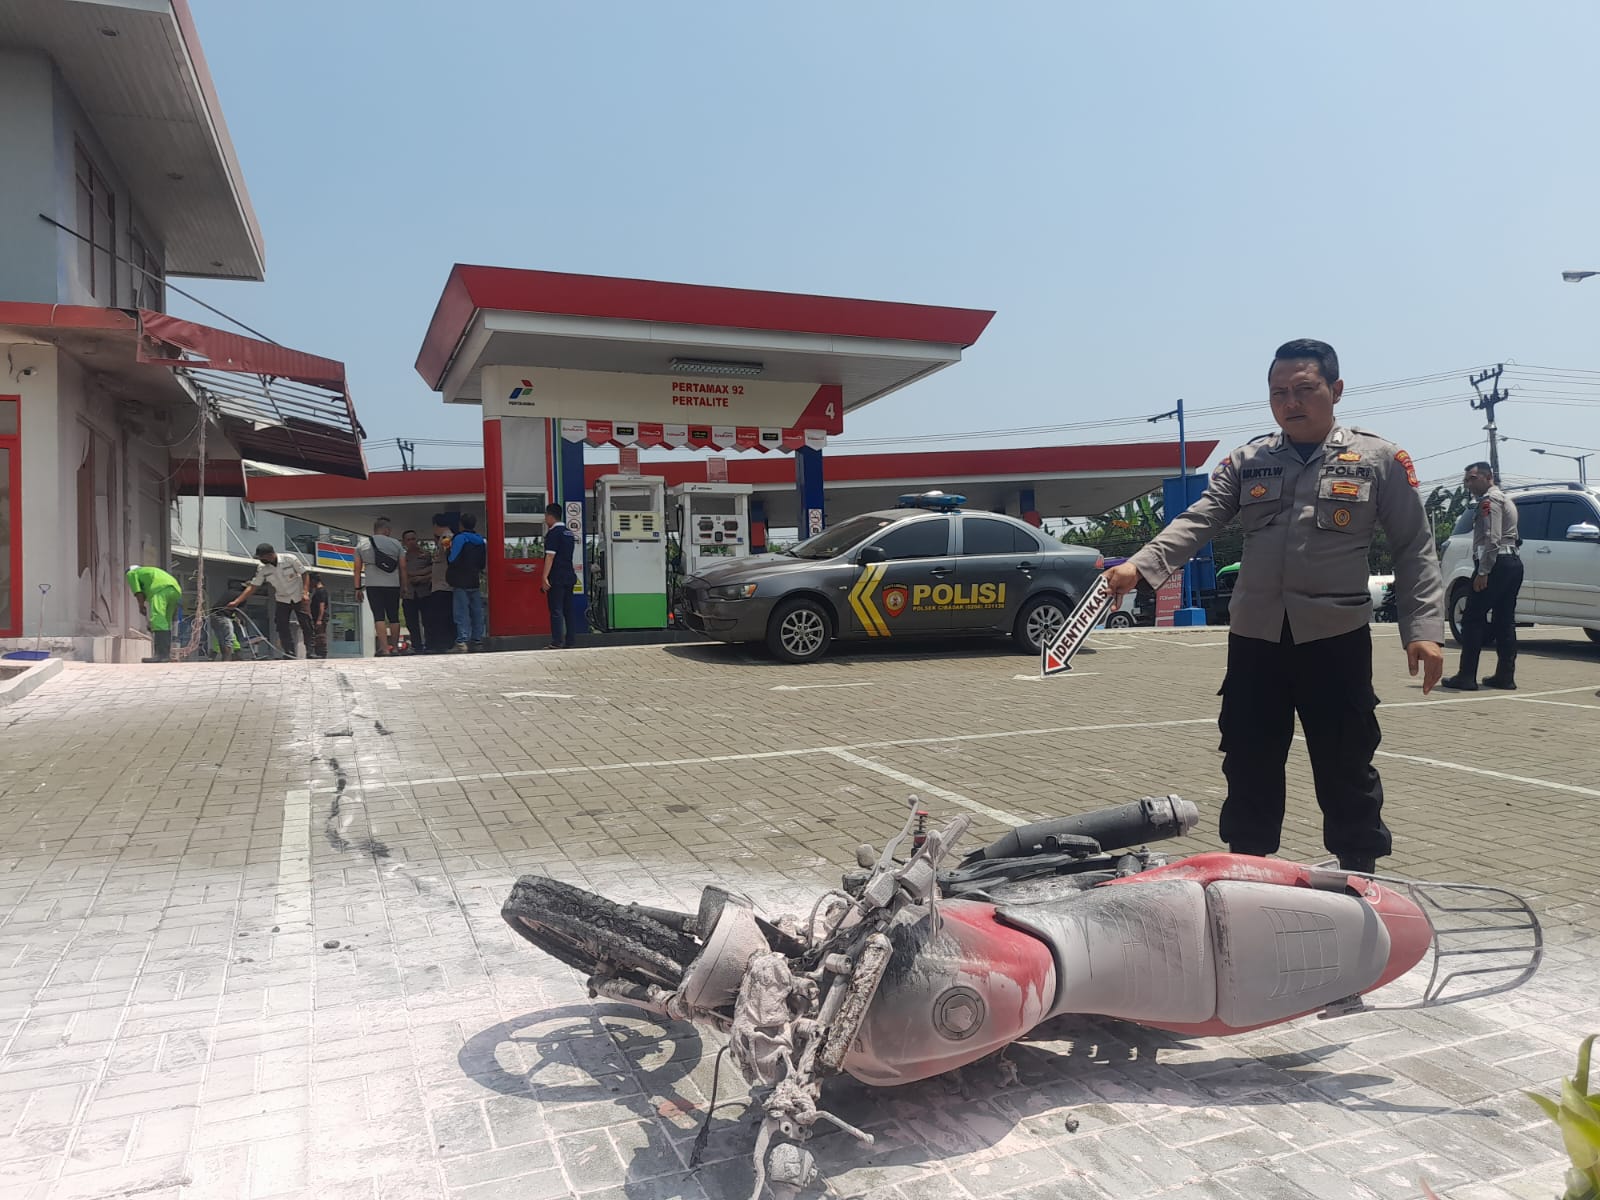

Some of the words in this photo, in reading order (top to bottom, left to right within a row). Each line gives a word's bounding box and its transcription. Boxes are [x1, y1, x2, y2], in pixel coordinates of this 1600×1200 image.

[672, 382, 729, 394] PERTAMAX
[732, 385, 744, 395] 92
[672, 396, 729, 407] PERTALITE
[825, 402, 835, 420] 4
[1325, 466, 1372, 478] POLRI
[912, 583, 1006, 606] POLISI
